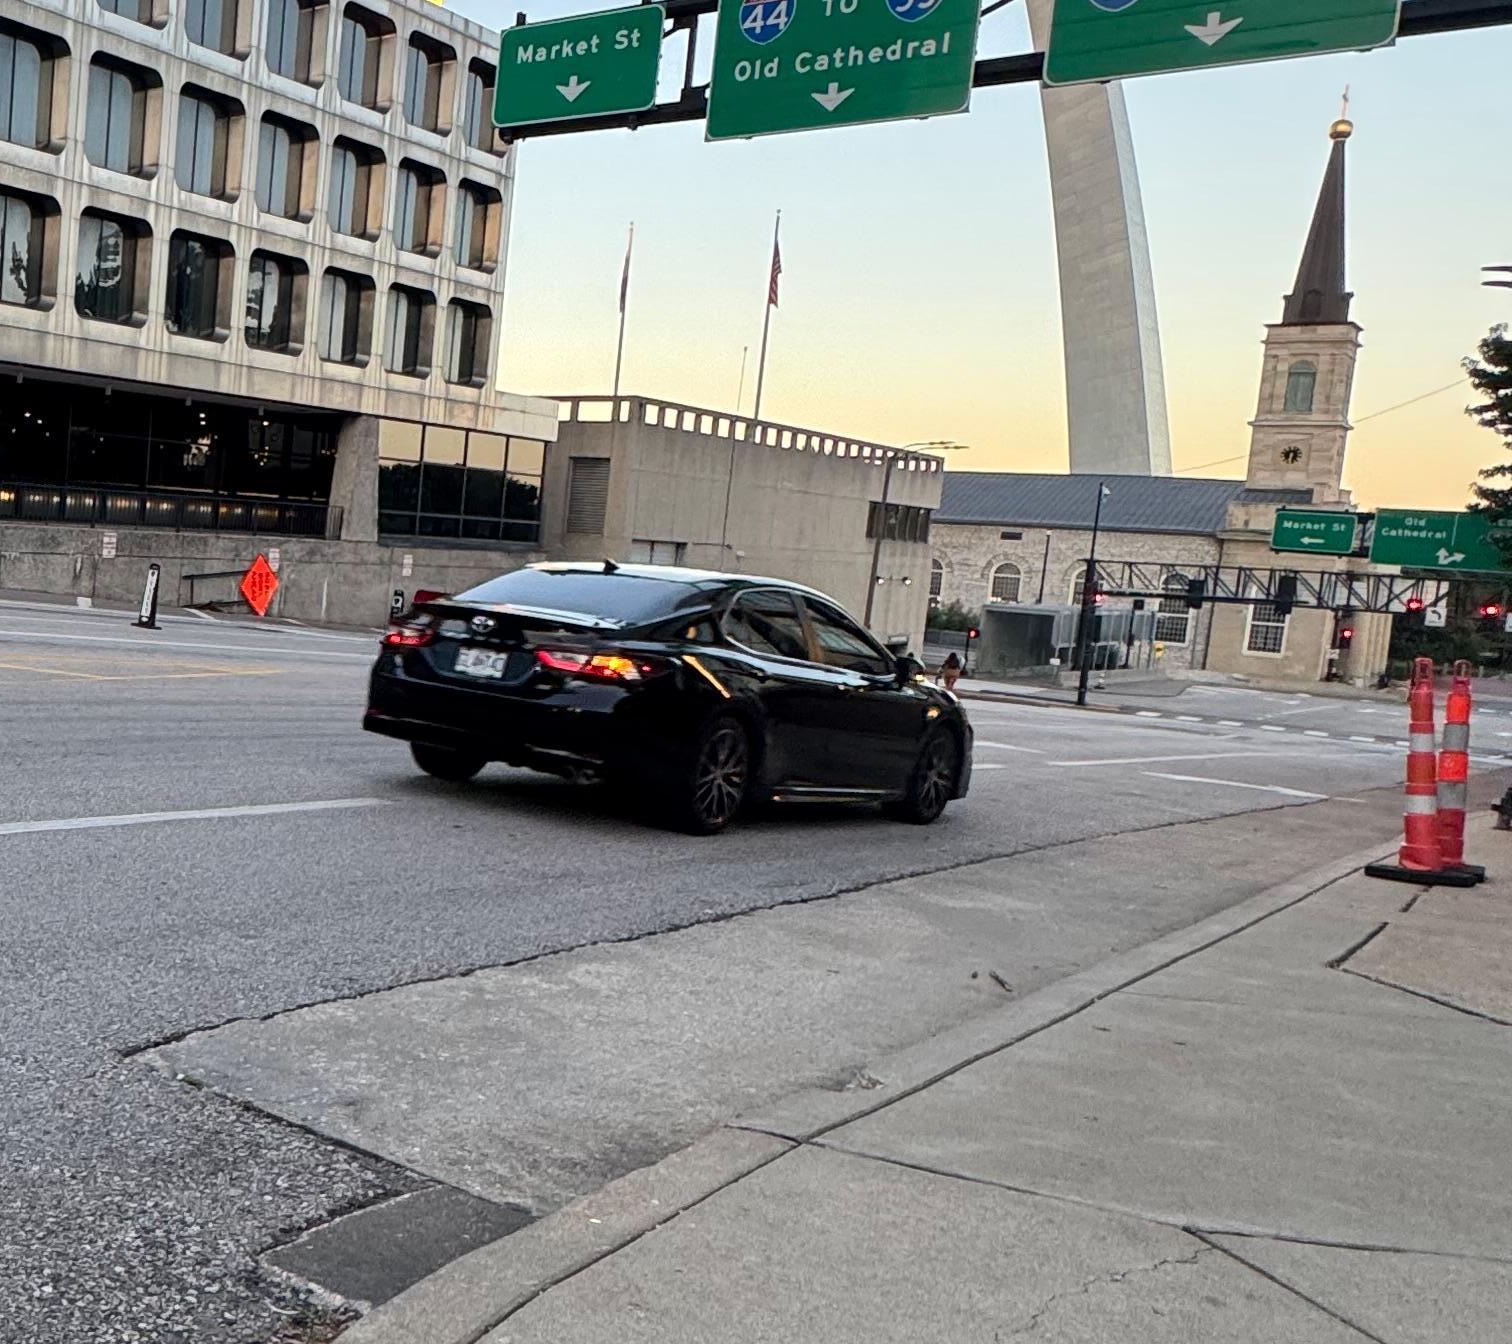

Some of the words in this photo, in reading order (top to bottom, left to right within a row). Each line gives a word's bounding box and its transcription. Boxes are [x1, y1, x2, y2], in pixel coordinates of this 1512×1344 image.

[743, 1, 789, 34] 44
[516, 34, 600, 64] Market
[614, 28, 641, 50] St
[734, 57, 779, 82] Old
[794, 32, 951, 74] Cathedral
[1281, 519, 1326, 531] Market
[1331, 522, 1347, 532] St
[1381, 527, 1447, 539] Cathedral
[1405, 517, 1427, 527] Old
